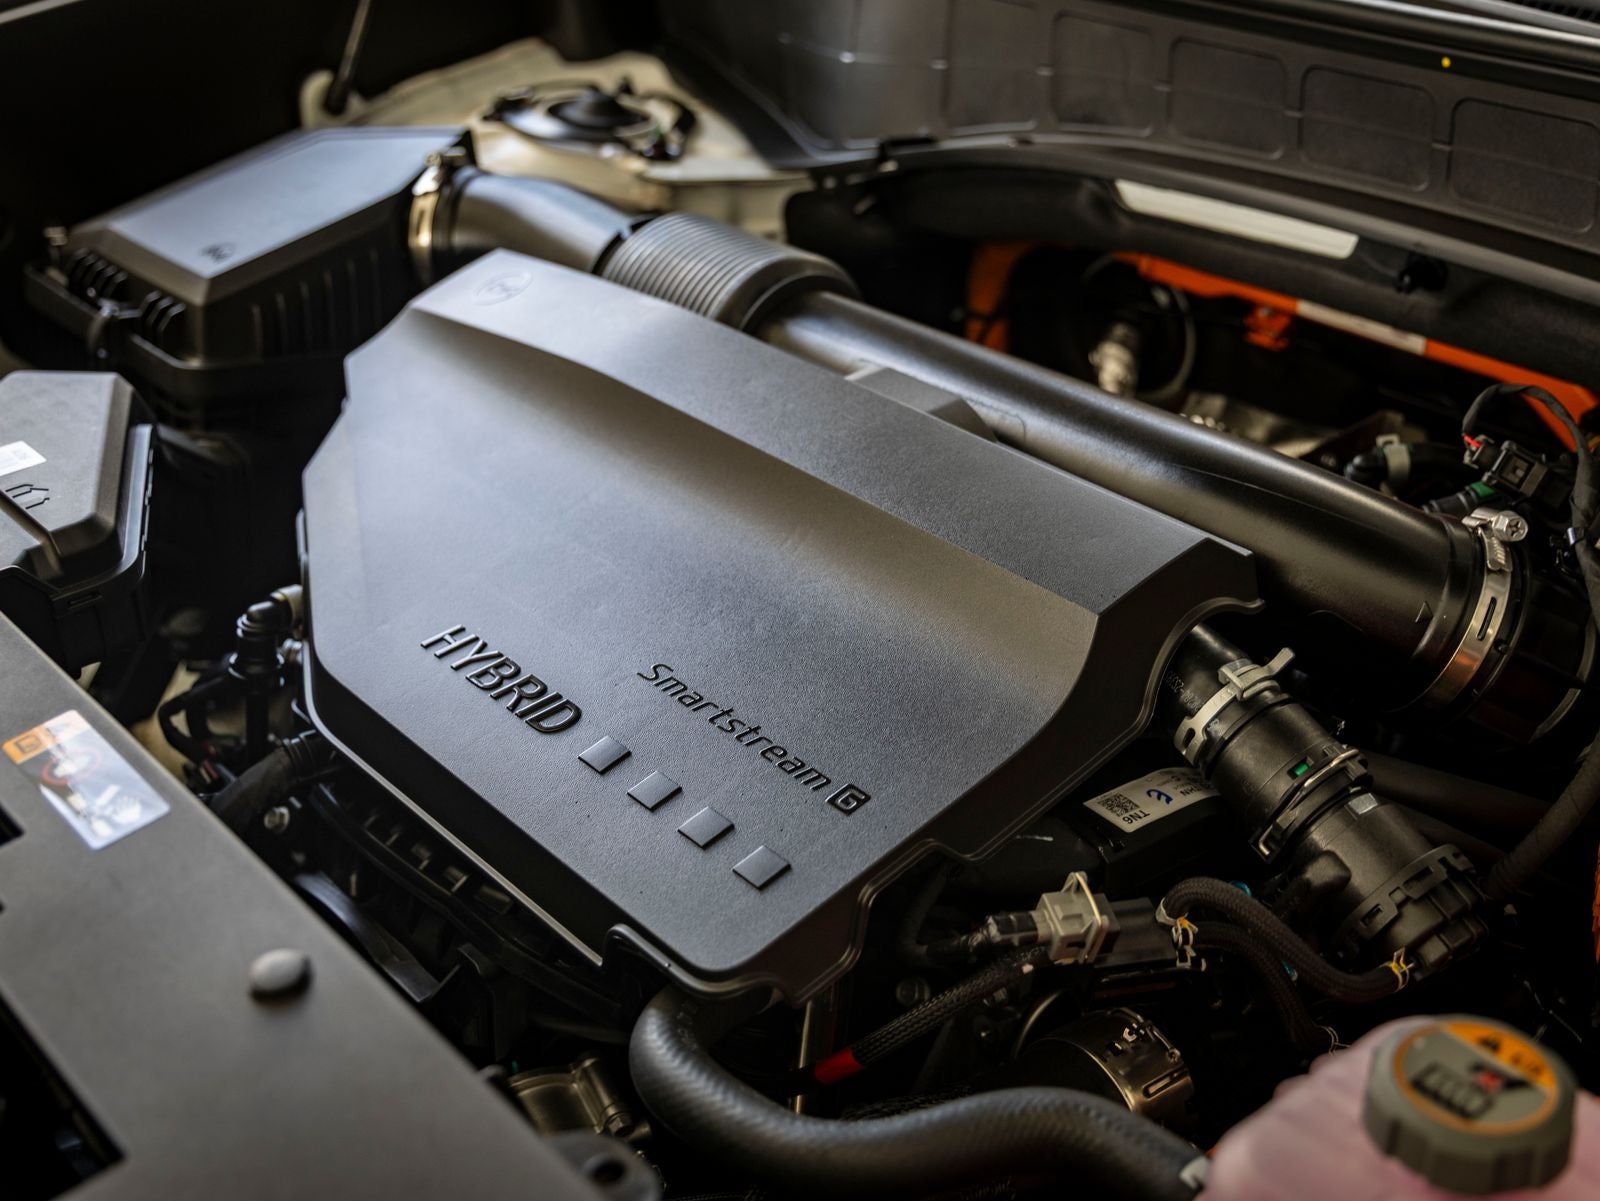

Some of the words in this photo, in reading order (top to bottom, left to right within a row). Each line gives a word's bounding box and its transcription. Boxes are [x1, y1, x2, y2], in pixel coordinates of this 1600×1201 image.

[420, 624, 583, 734] HYBRID
[637, 663, 832, 791] Smartstream
[830, 785, 870, 814] G
[1122, 809, 1151, 824] TN6
